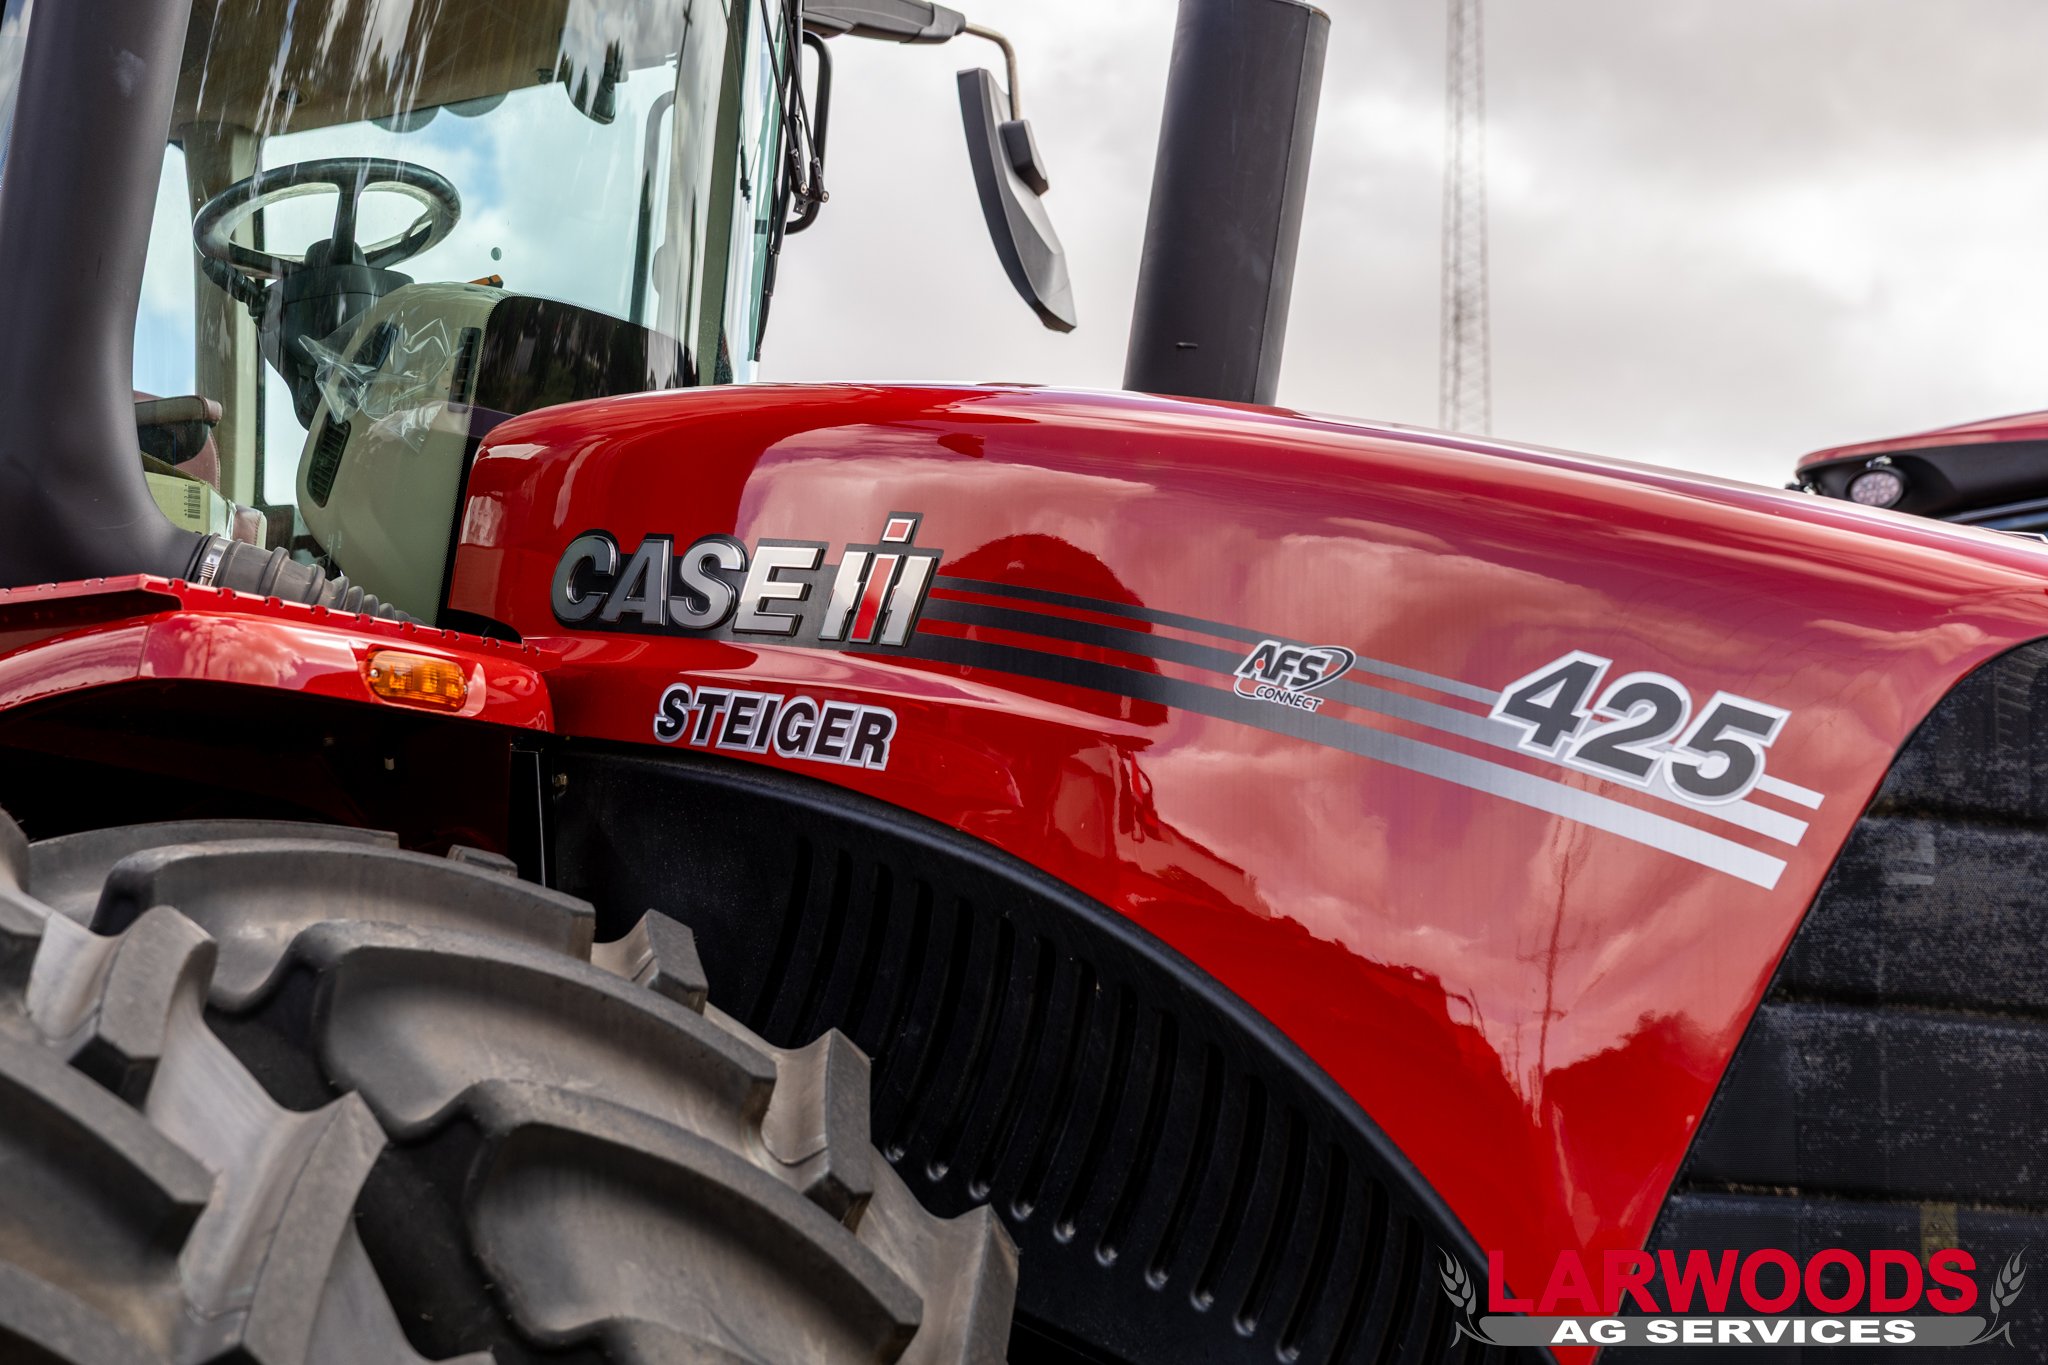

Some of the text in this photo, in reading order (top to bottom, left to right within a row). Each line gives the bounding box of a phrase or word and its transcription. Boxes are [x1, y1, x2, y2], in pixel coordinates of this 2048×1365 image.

[552, 530, 825, 636] CASE
[1237, 641, 1330, 688] AFS
[1255, 685, 1322, 711] CONNECT
[654, 684, 896, 769] STEIGER
[1492, 652, 1790, 803] 425
